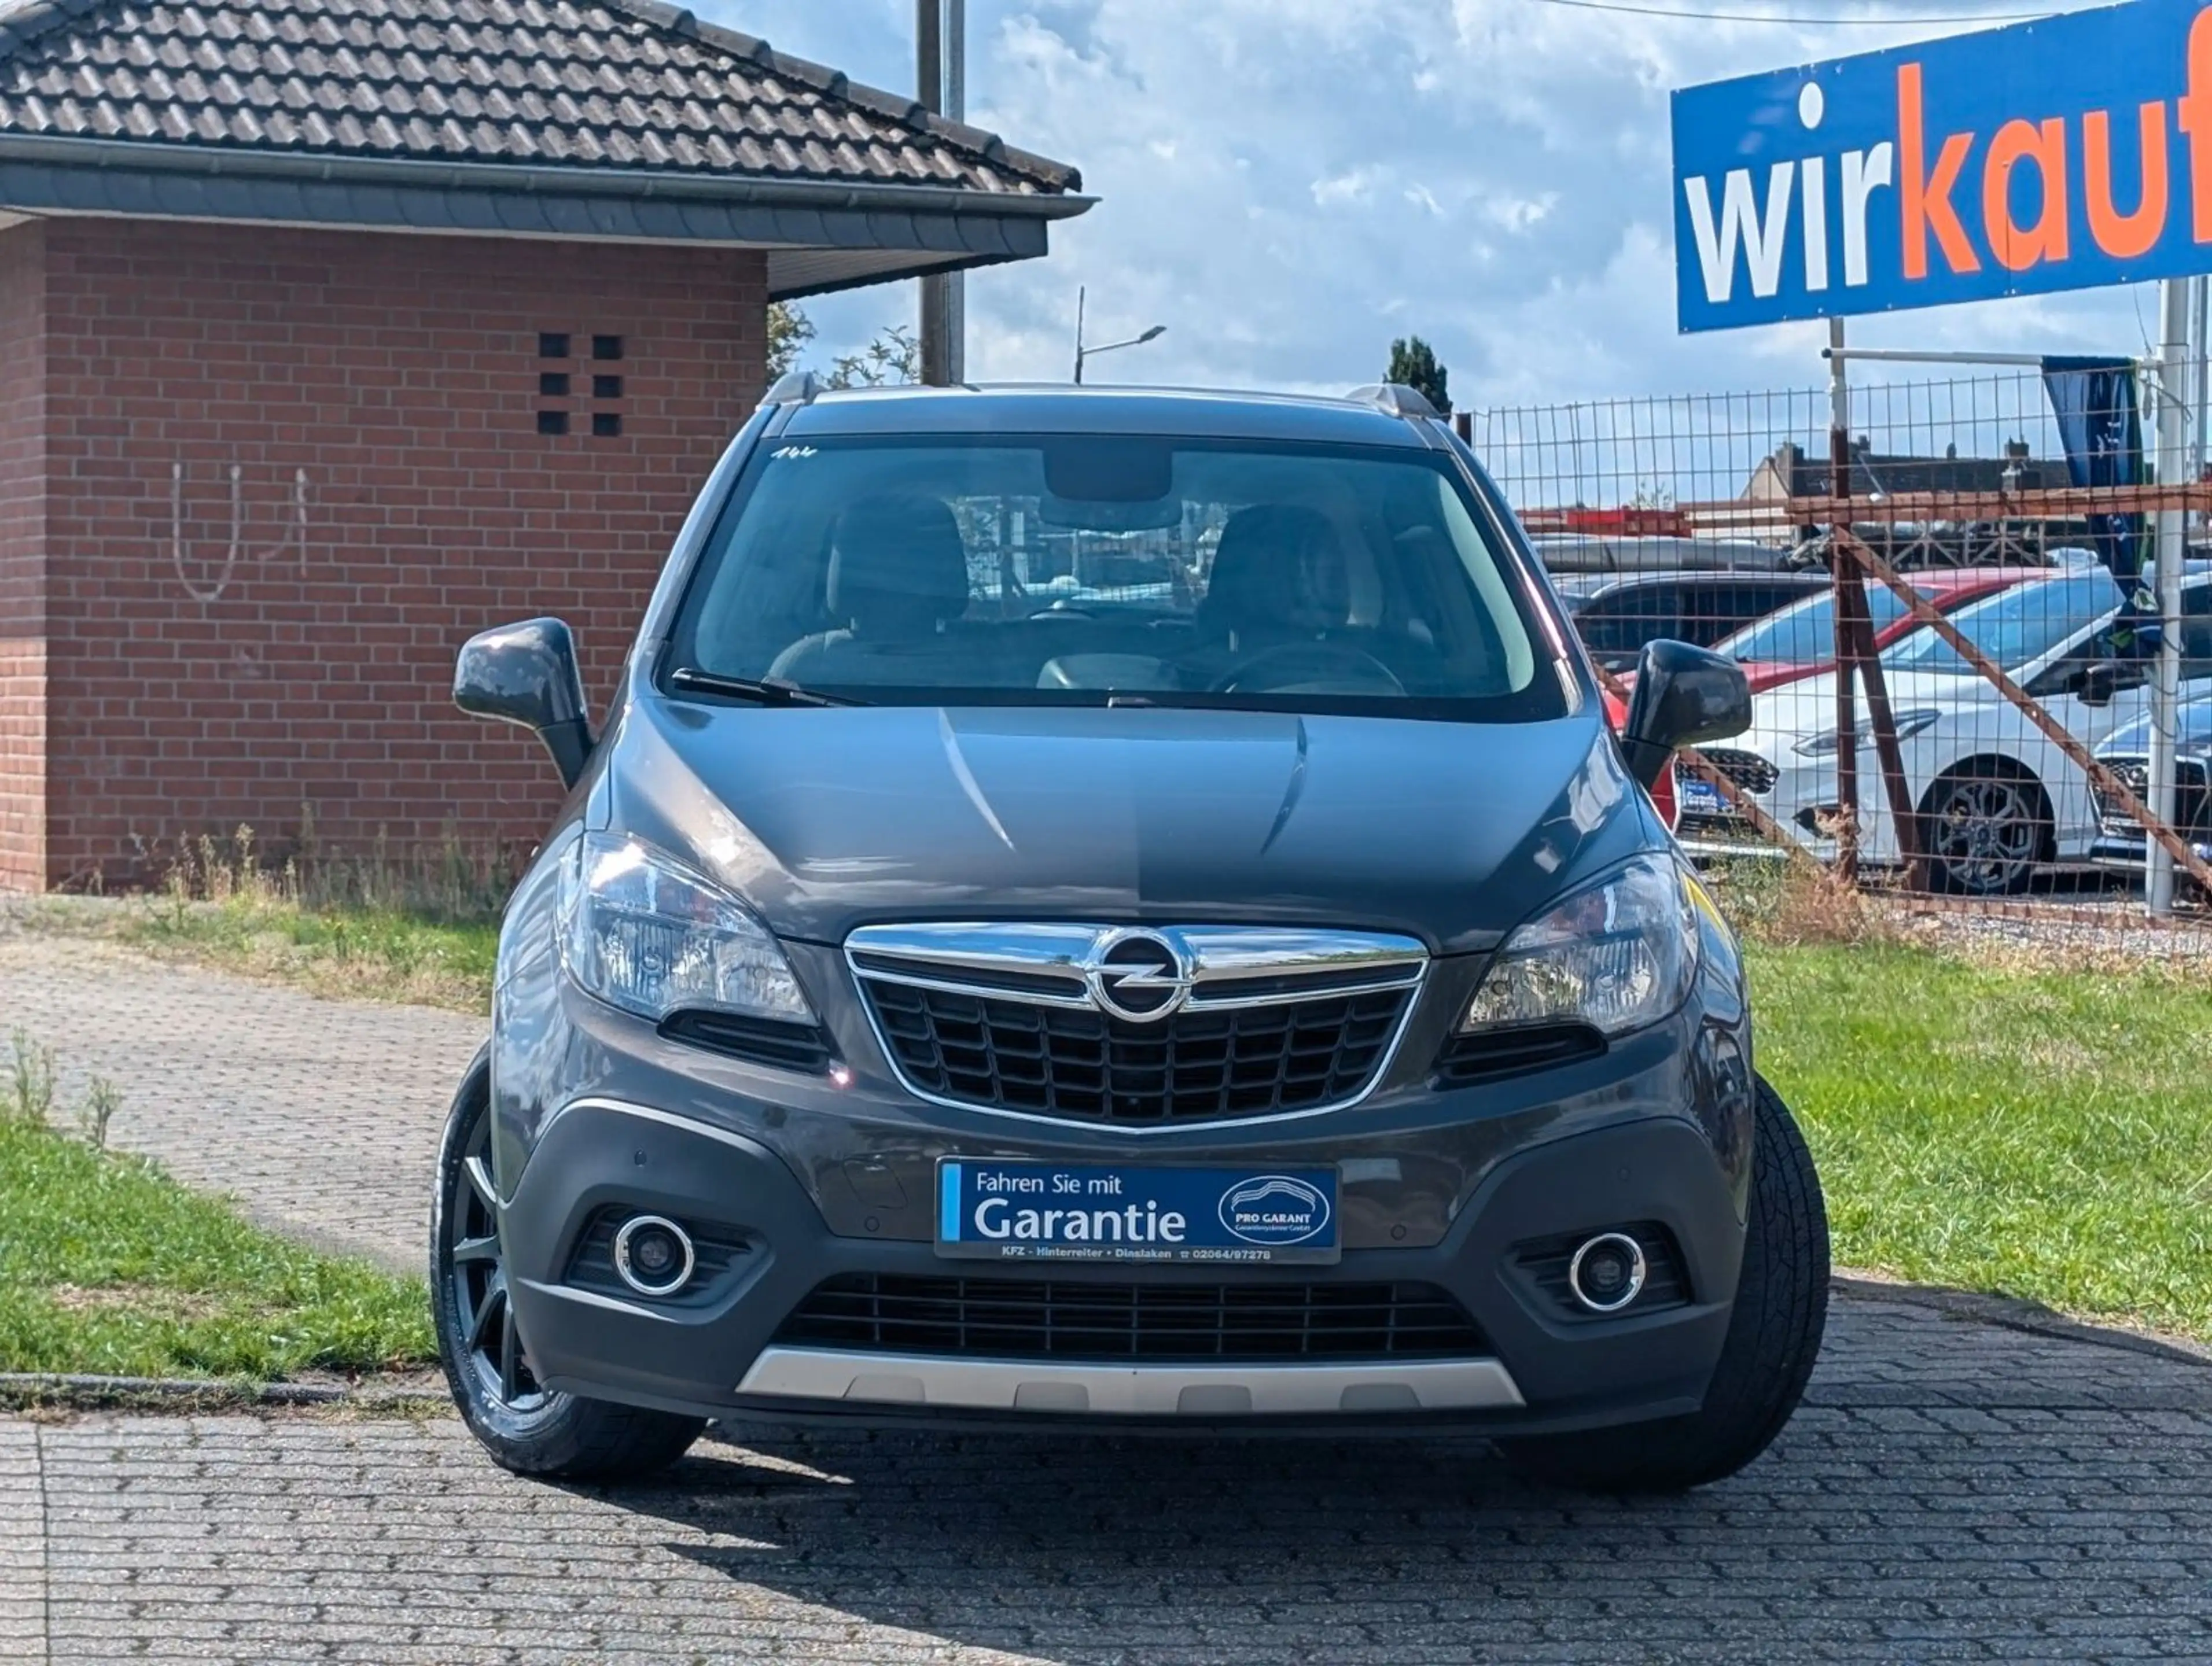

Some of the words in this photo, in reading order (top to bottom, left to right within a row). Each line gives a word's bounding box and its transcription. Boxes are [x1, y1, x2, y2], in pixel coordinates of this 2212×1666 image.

[976, 1171, 1044, 1193] Fahren
[1052, 1173, 1081, 1194] Sie
[1088, 1175, 1123, 1195] mit
[974, 1197, 1187, 1243] Garantie
[1235, 1213, 1260, 1223] PRO
[1261, 1213, 1312, 1224] GARANT
[1001, 1245, 1026, 1256] KFZ
[1036, 1246, 1103, 1258] Hinterreiter
[1114, 1248, 1172, 1259] Dinslaken
